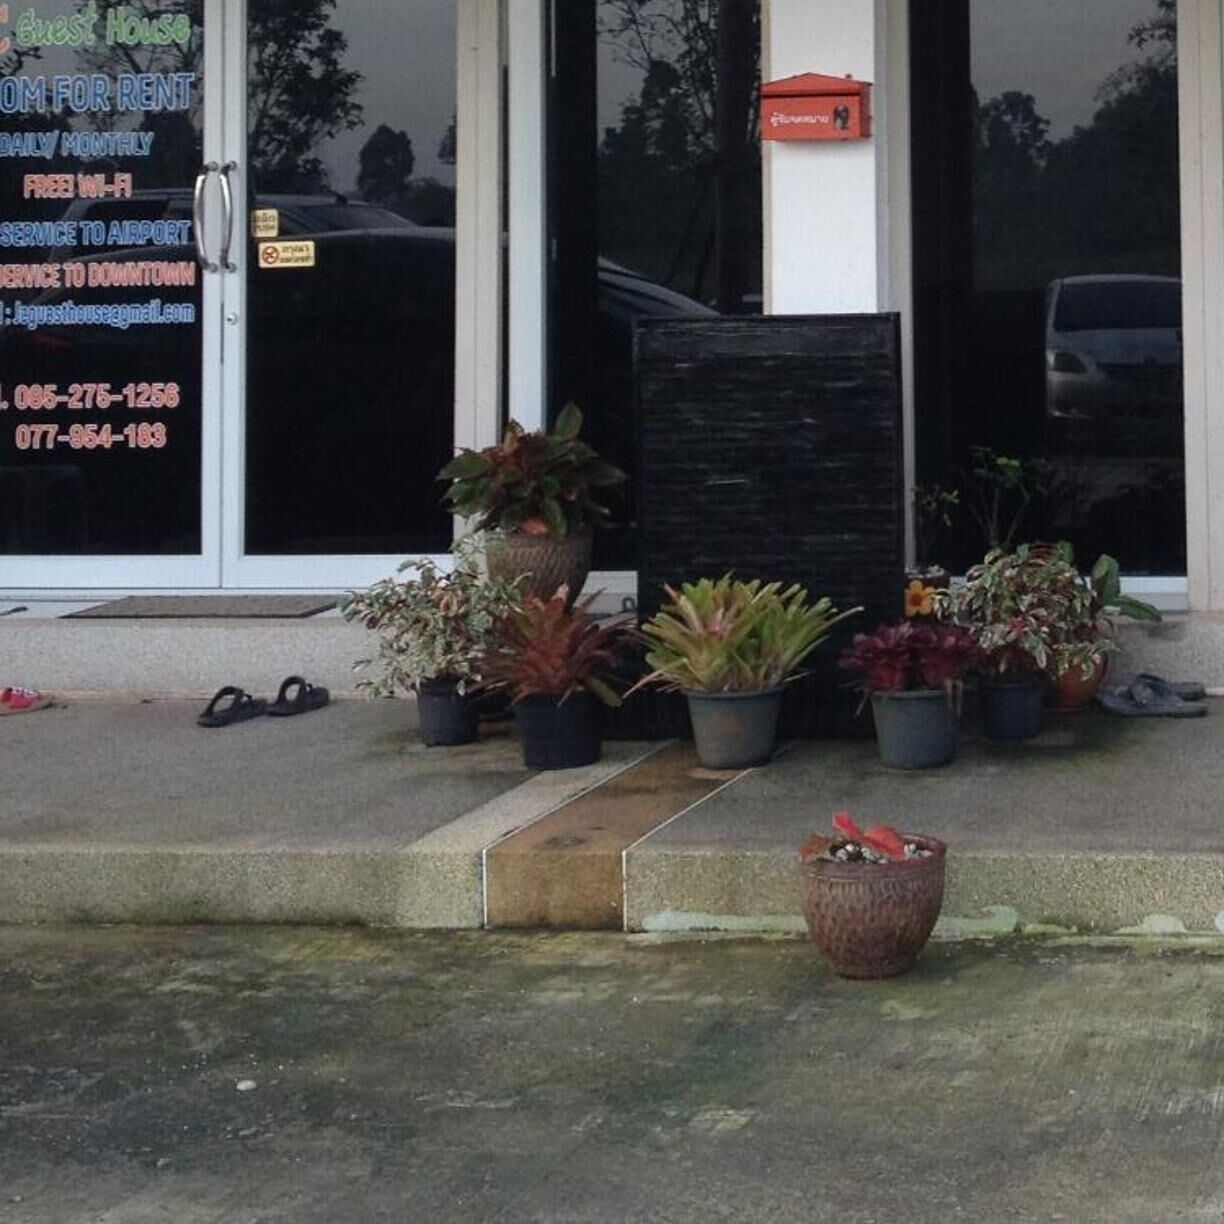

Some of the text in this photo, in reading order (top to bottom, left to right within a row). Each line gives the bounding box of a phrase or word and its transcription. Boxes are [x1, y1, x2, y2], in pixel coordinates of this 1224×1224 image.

[16, 0, 99, 46] Guest
[106, 5, 191, 46] House
[52, 74, 111, 113] FOR
[117, 71, 195, 112] RENT
[61, 131, 154, 157] MONTHLY
[0, 218, 192, 247] SERVICE TO AIRPORT
[63, 262, 86, 288] TO
[88, 260, 196, 287] DOWNTOWN
